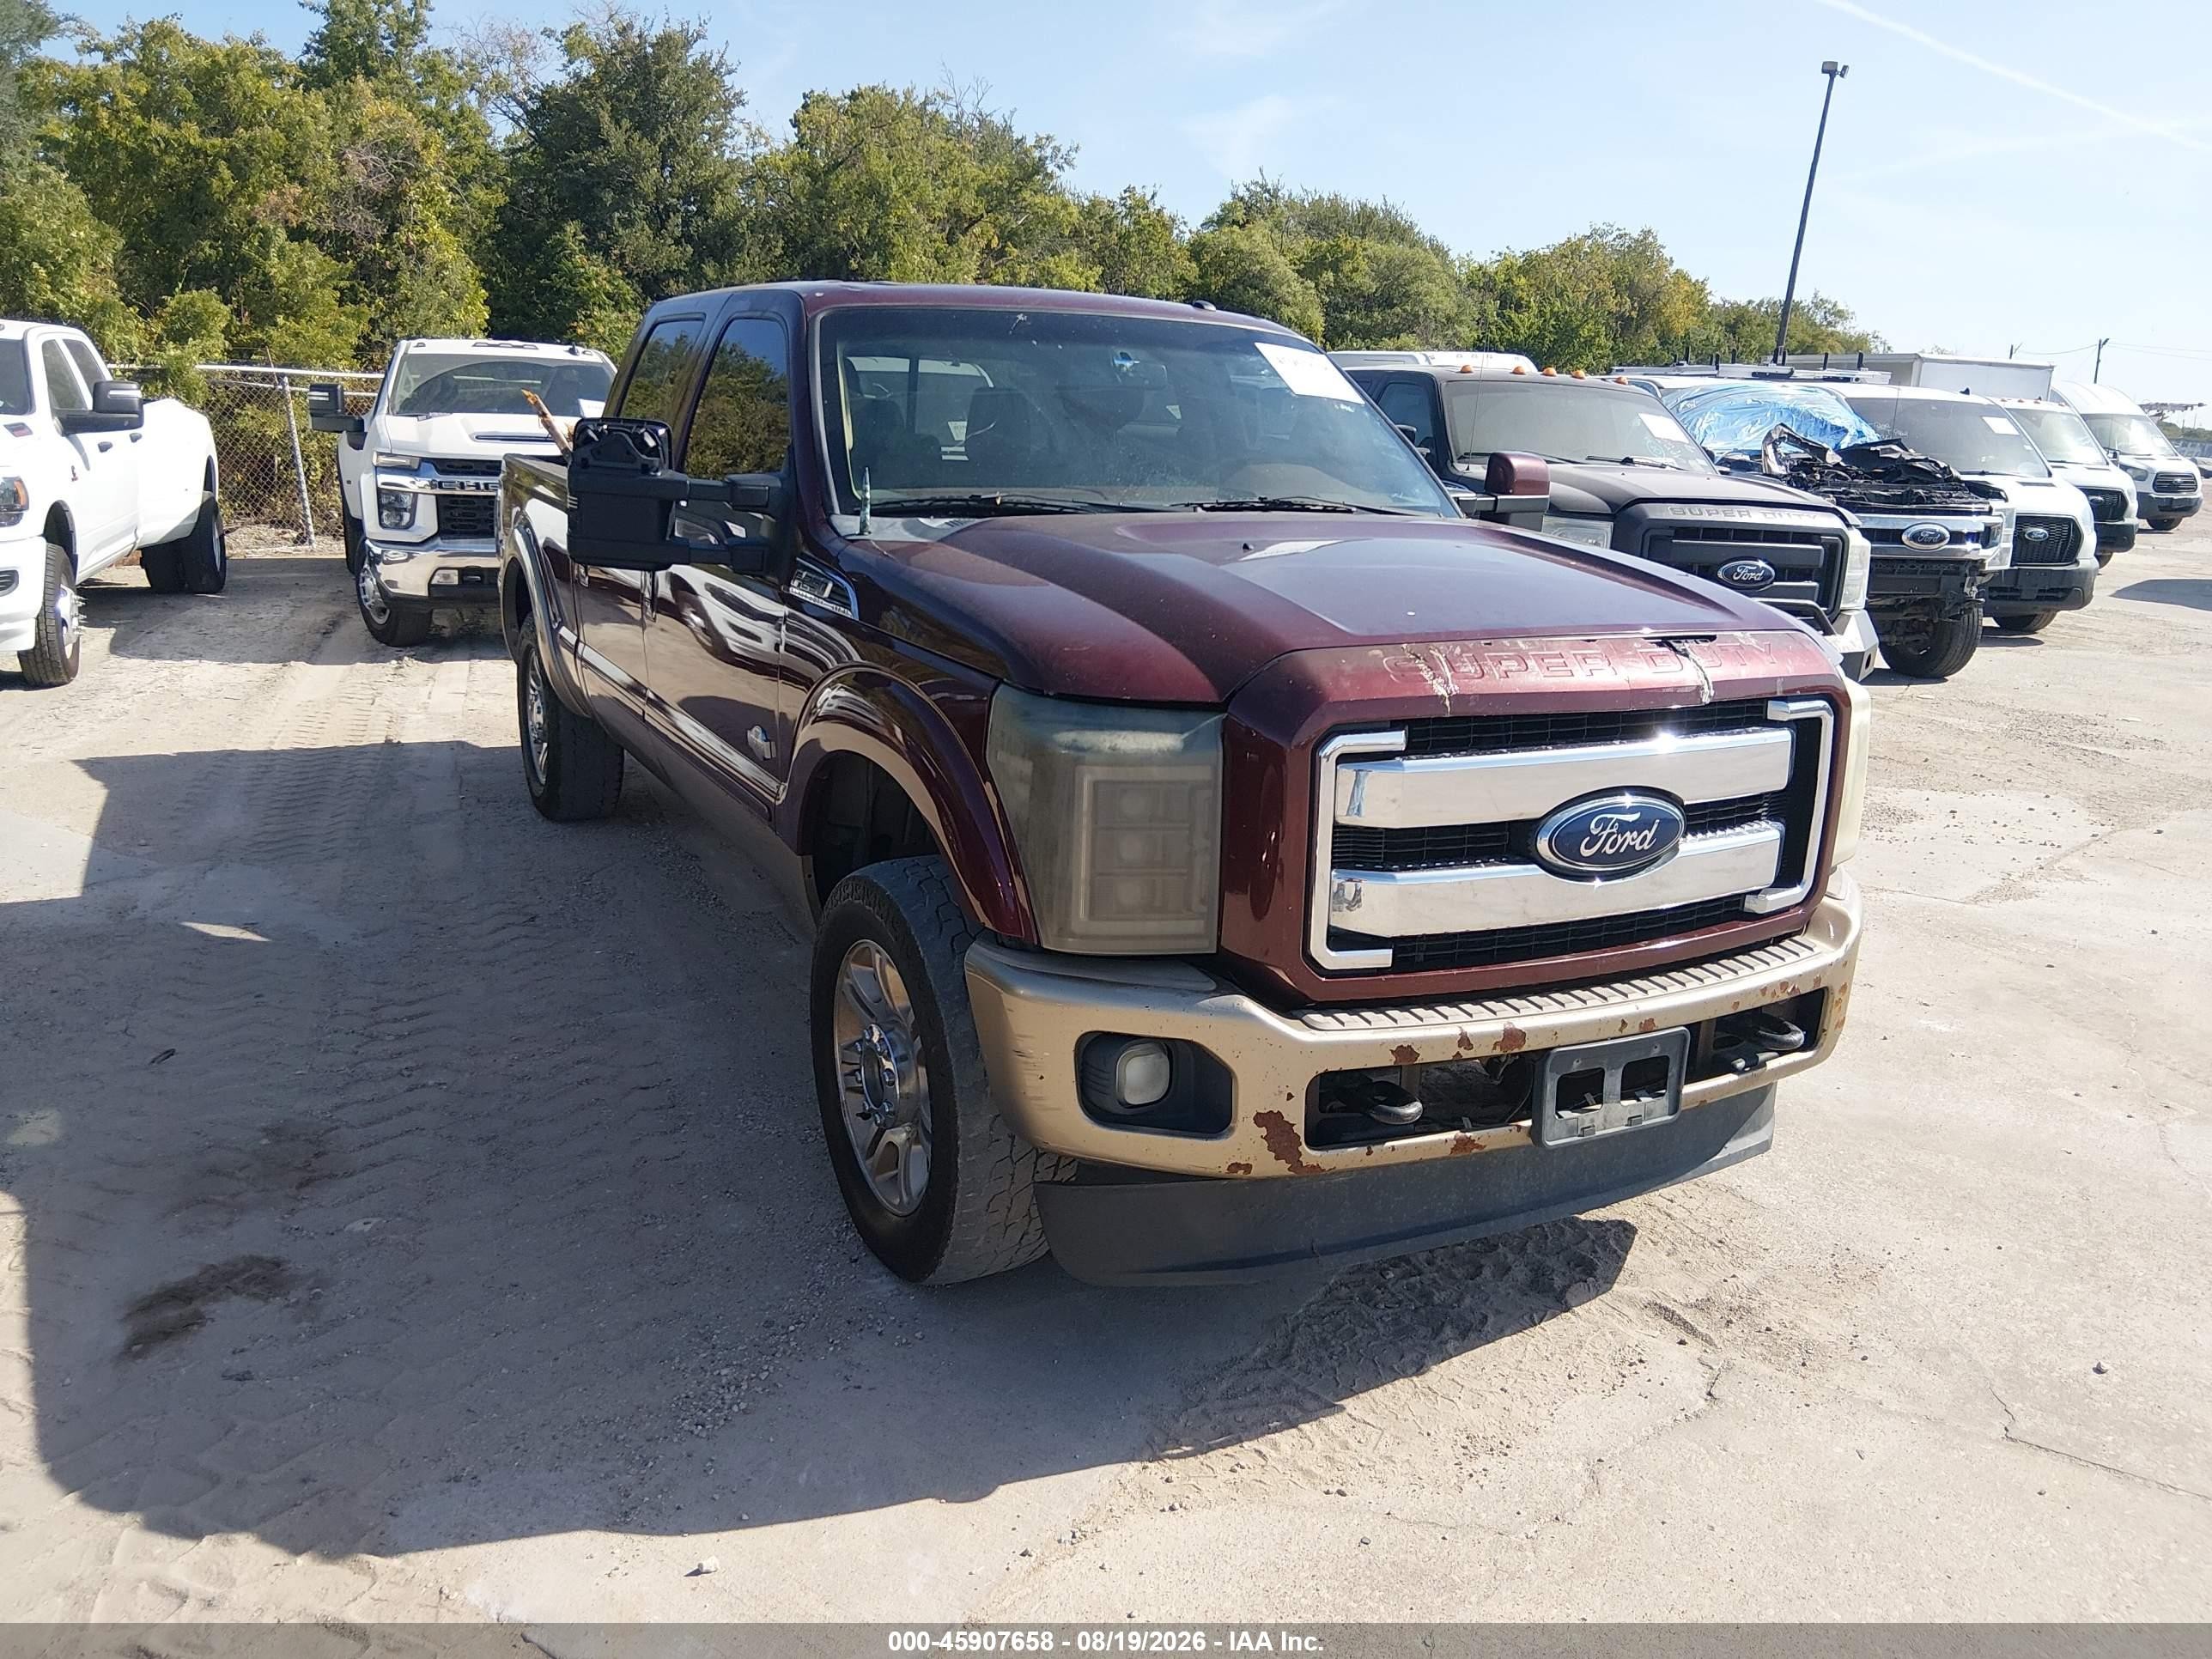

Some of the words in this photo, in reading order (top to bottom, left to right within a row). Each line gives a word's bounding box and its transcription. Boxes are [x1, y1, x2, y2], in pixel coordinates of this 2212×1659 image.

[1668, 506, 1752, 519] SUPER
[1759, 510, 1817, 520] DUTY
[1917, 531, 1941, 544] Ford
[1732, 564, 1764, 581] Ford
[1382, 650, 1618, 684] SUPER
[1637, 642, 1778, 674] DUTY
[1580, 811, 1660, 857] Ford
